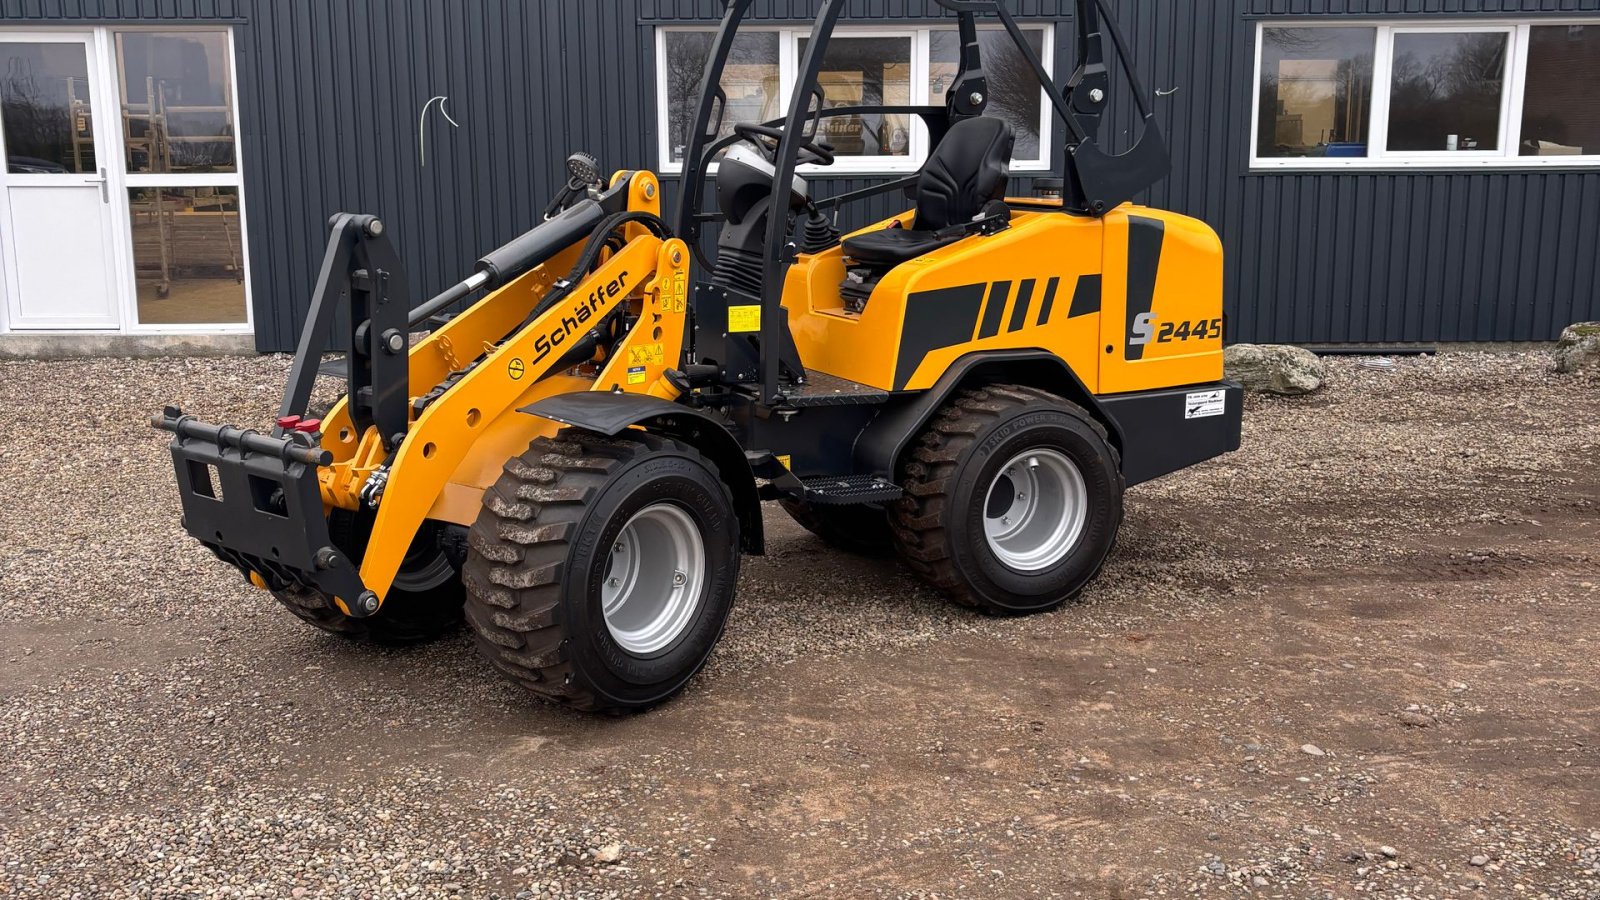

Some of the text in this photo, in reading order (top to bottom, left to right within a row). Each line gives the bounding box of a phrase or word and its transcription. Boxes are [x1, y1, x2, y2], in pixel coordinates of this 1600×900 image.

[532, 270, 628, 365] Schäffer
[1129, 312, 1222, 345] S 2445
[990, 427, 1010, 446] SKID
[1012, 414, 1046, 430] POWER
